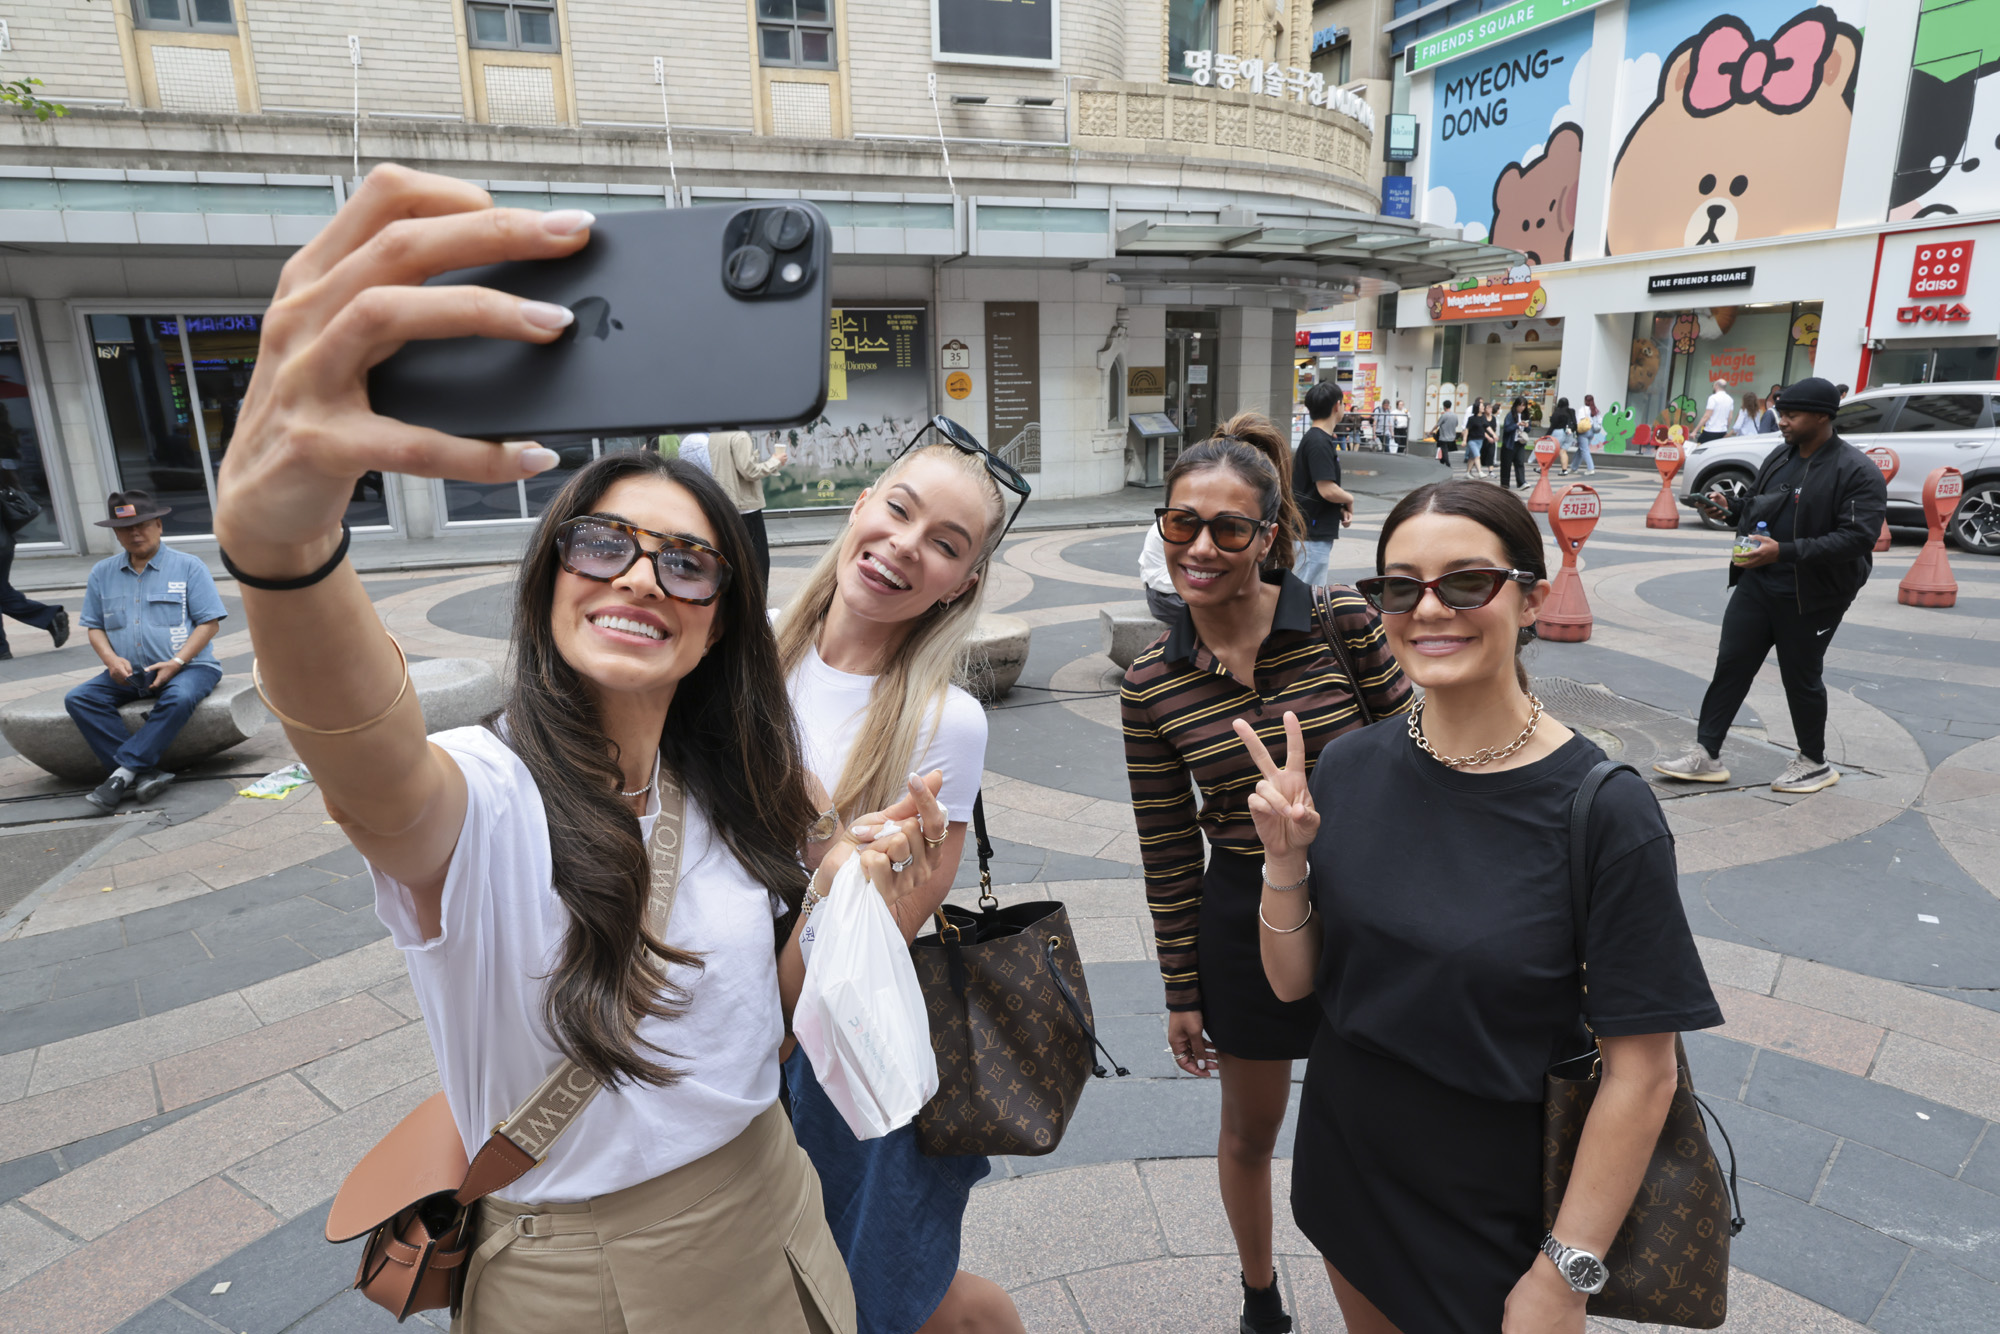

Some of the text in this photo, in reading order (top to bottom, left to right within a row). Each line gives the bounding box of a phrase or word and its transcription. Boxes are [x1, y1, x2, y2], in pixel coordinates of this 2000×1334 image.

[1422, 5, 1534, 60] FRIENDS SQUARE
[1183, 50, 1325, 106] 명동예술극장
[1442, 98, 1508, 141] DONG
[1652, 271, 1747, 288] LINE FRIENDS SQUARE
[1915, 278, 1957, 292] daiso
[1896, 302, 1971, 323] 다이소
[830, 336, 889, 354] 오니소스
[950, 352, 961, 361] 35
[1710, 353, 1756, 370] Wagla
[1658, 451, 1678, 459] 주차금지
[1873, 459, 1890, 468] 금지
[1938, 483, 1960, 495] 주차금지
[1562, 502, 1596, 516] 주차금지
[647, 812, 680, 919] LOEWE
[509, 1067, 596, 1153] OEWE
